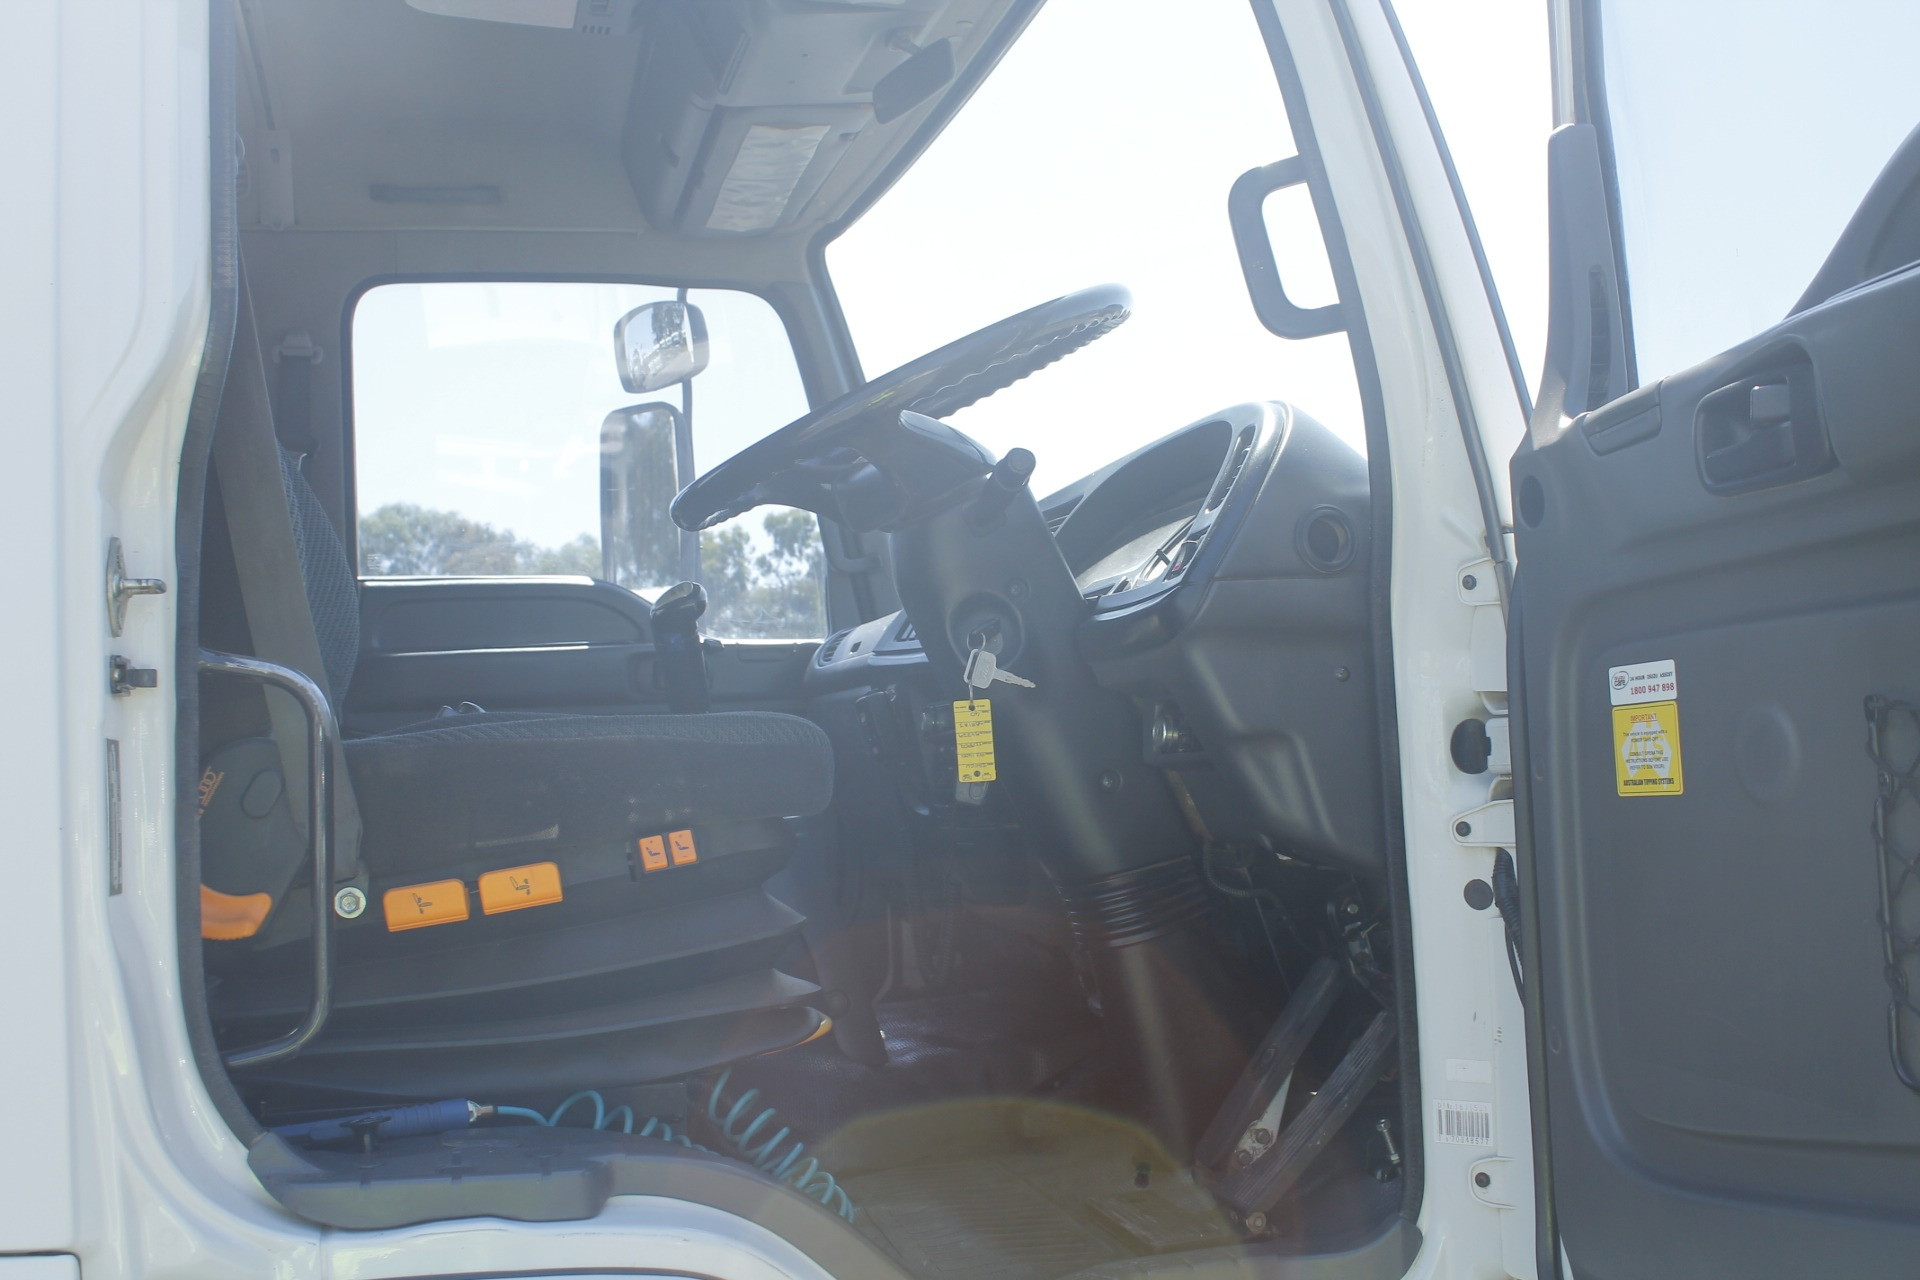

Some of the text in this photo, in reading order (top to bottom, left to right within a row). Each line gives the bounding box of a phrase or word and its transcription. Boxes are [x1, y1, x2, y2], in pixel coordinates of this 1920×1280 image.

[1630, 682, 1675, 695] 1800 947 898
[1630, 713, 1657, 721] IMPORTANT
